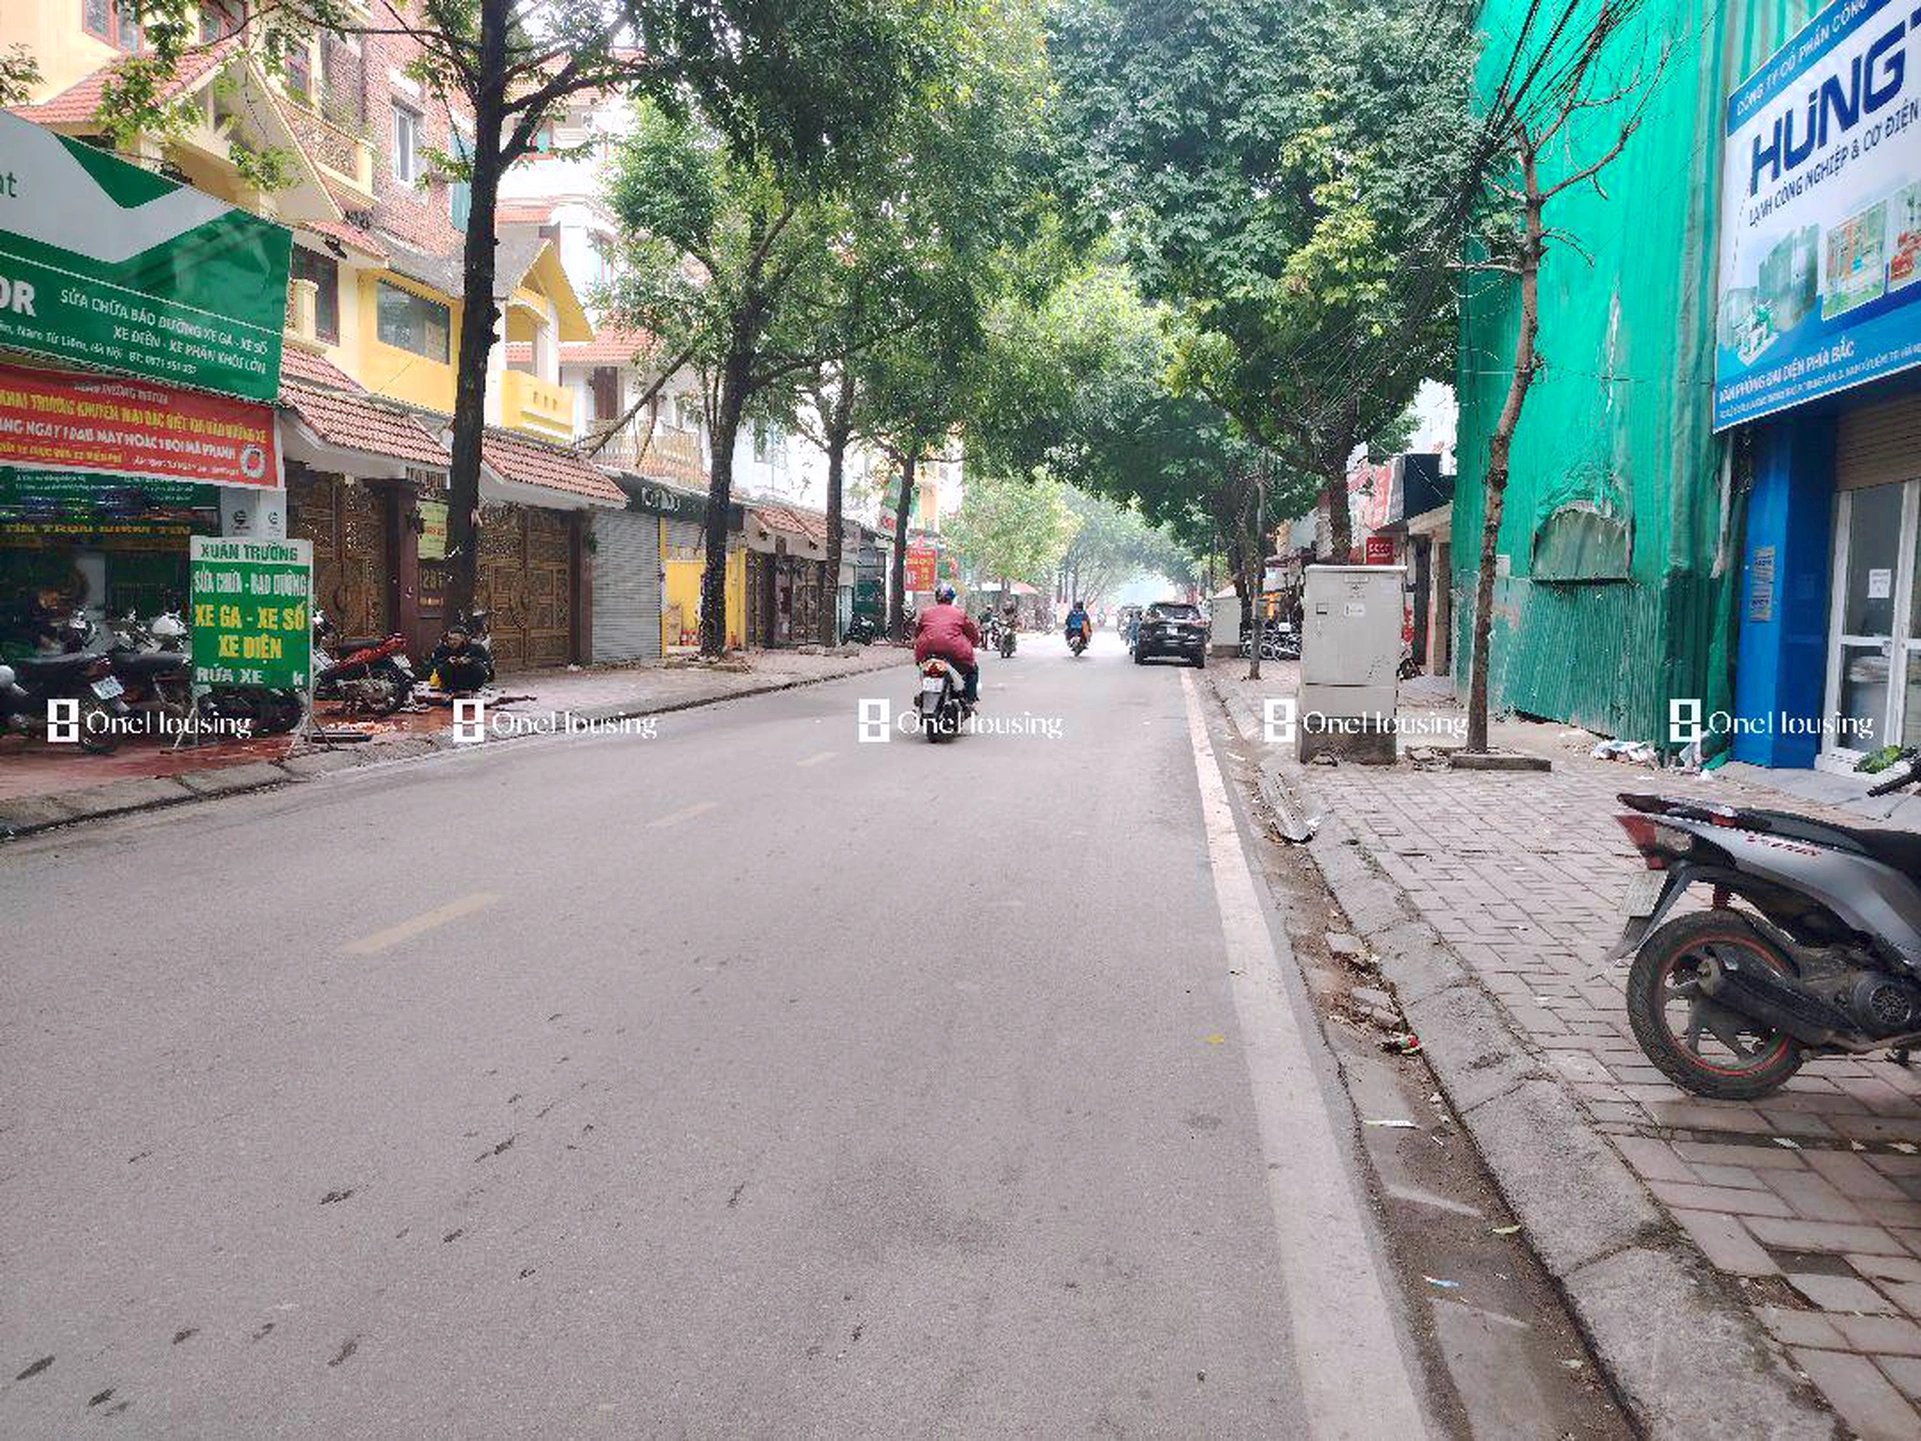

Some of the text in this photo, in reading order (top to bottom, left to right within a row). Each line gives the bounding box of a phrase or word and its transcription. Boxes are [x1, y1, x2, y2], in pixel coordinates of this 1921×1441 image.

[1805, 144, 1850, 189] NGHIỆP
[200, 540, 299, 562] XUÂN TRƯỜNG
[194, 604, 215, 627] XE
[220, 604, 243, 629] GA
[257, 606, 279, 630] XE
[282, 600, 306, 631] SỐ
[218, 635, 240, 658] XE
[239, 668, 264, 685] XE
